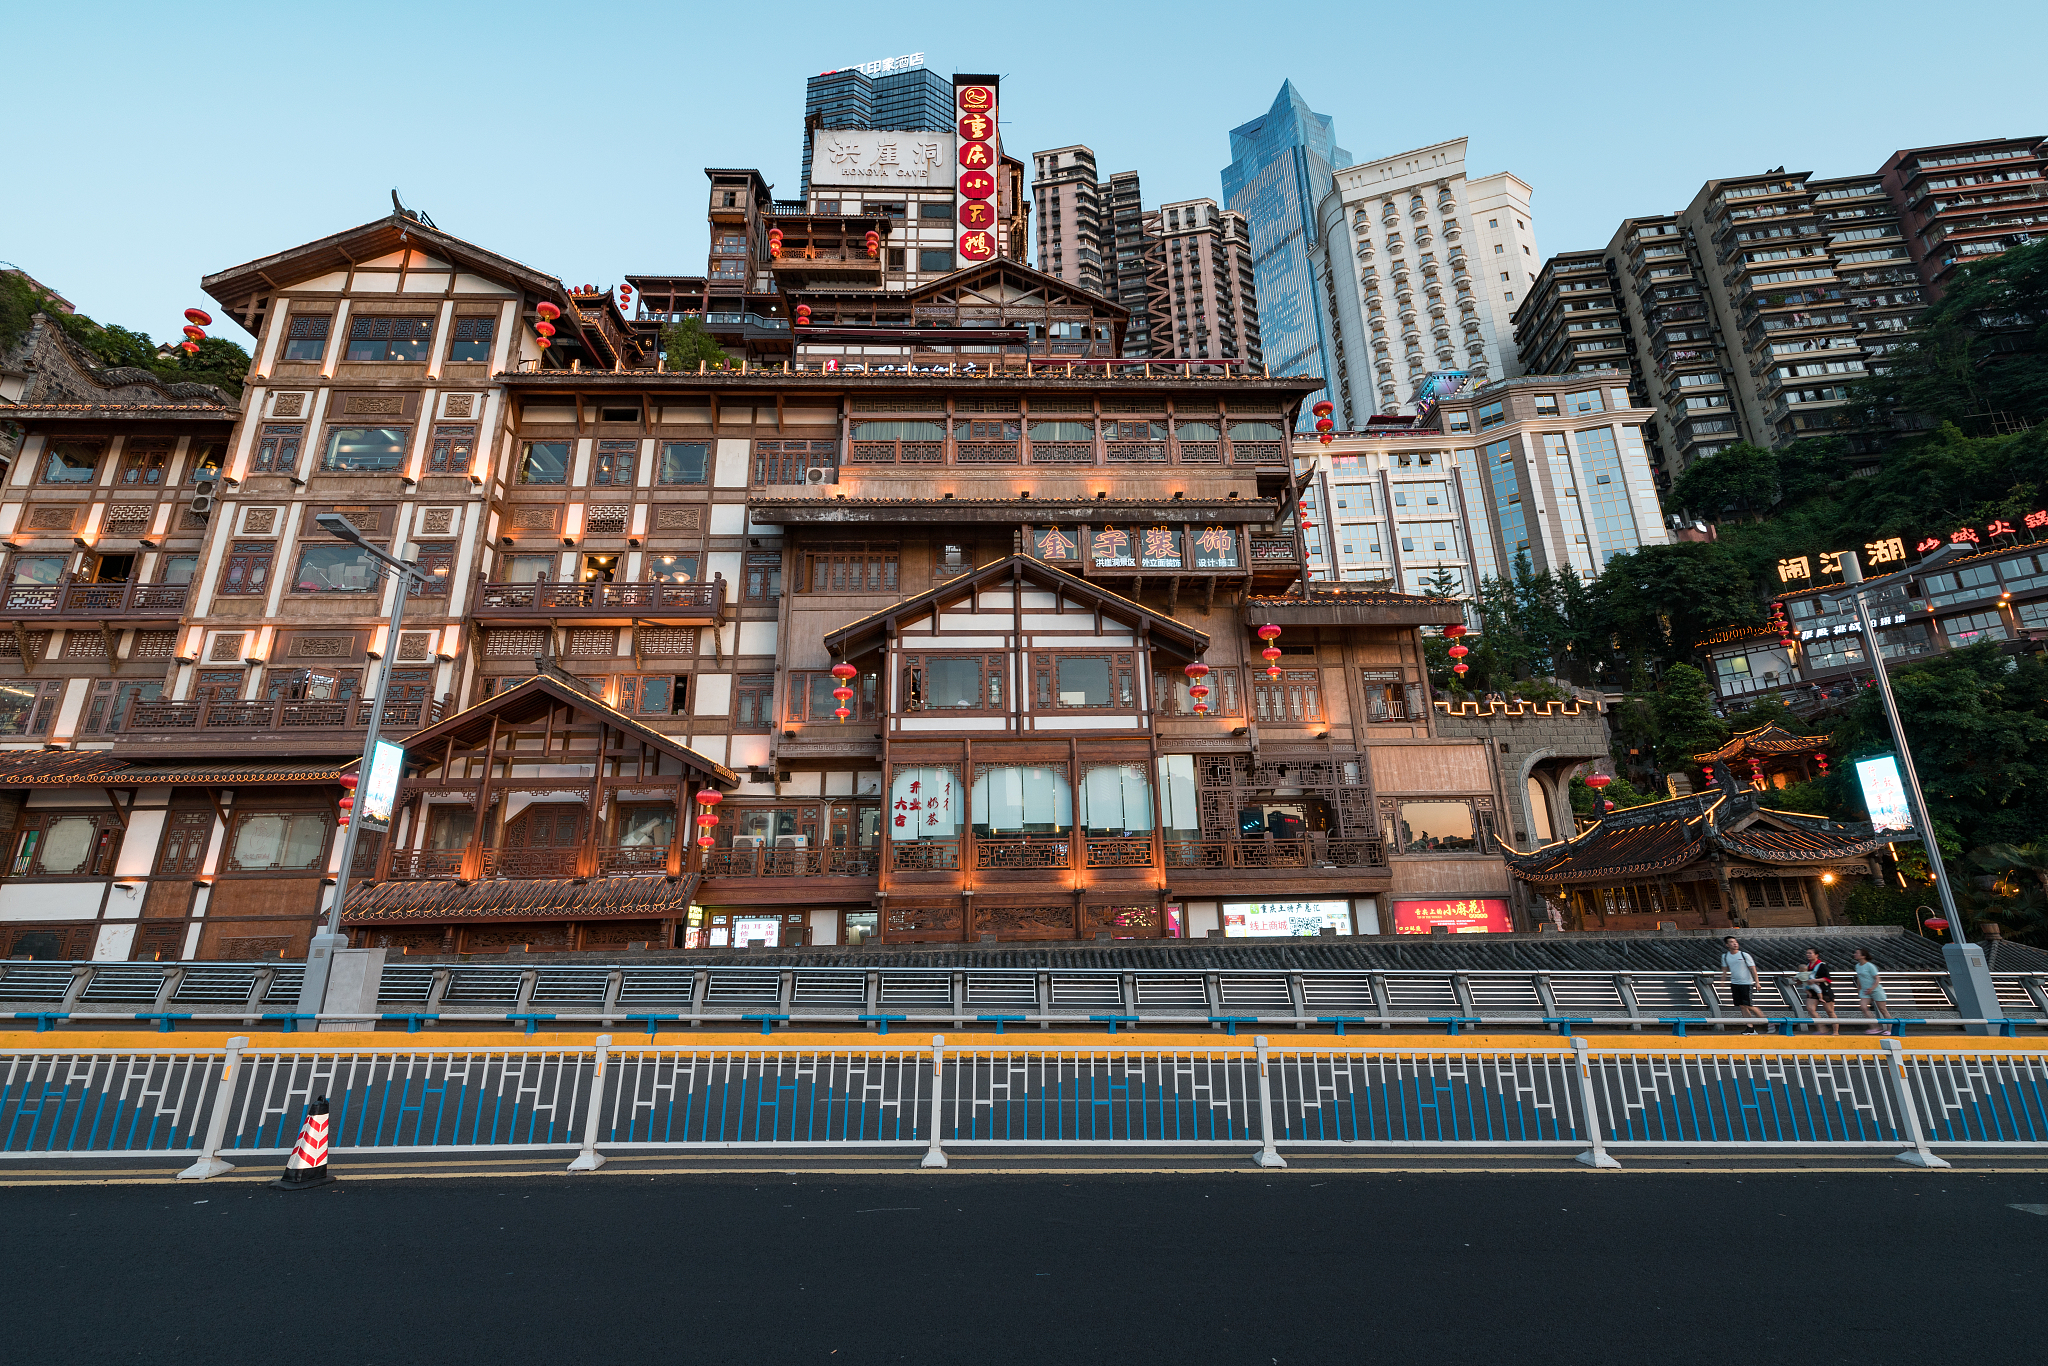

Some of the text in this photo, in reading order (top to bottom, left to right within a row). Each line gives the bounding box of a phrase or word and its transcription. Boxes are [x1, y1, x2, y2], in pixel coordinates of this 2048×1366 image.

[827, 138, 944, 168] 洪崖洞
[841, 168, 929, 178] HONGYA CAVE
[893, 796, 908, 828] 大吉
[926, 796, 939, 827] 奶茶
[1250, 920, 1289, 931] 线上商城
